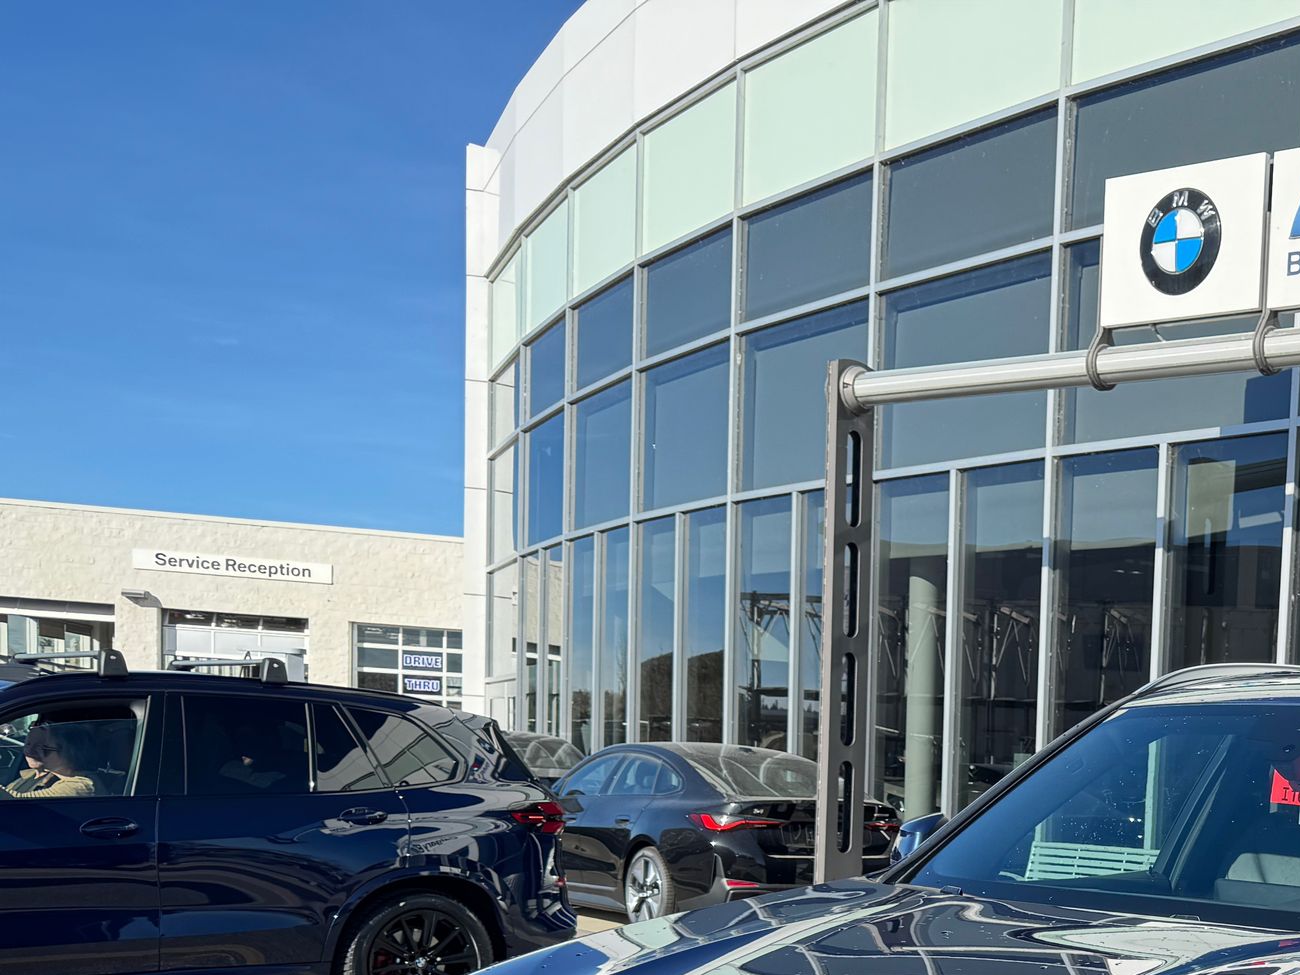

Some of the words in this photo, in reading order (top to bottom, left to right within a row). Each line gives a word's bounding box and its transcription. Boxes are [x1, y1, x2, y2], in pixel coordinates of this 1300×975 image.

[1146, 190, 1217, 228] BMW
[154, 552, 221, 571] Service
[225, 558, 312, 577] Reception
[404, 654, 442, 668] DRIVE
[405, 678, 440, 692] THRU
